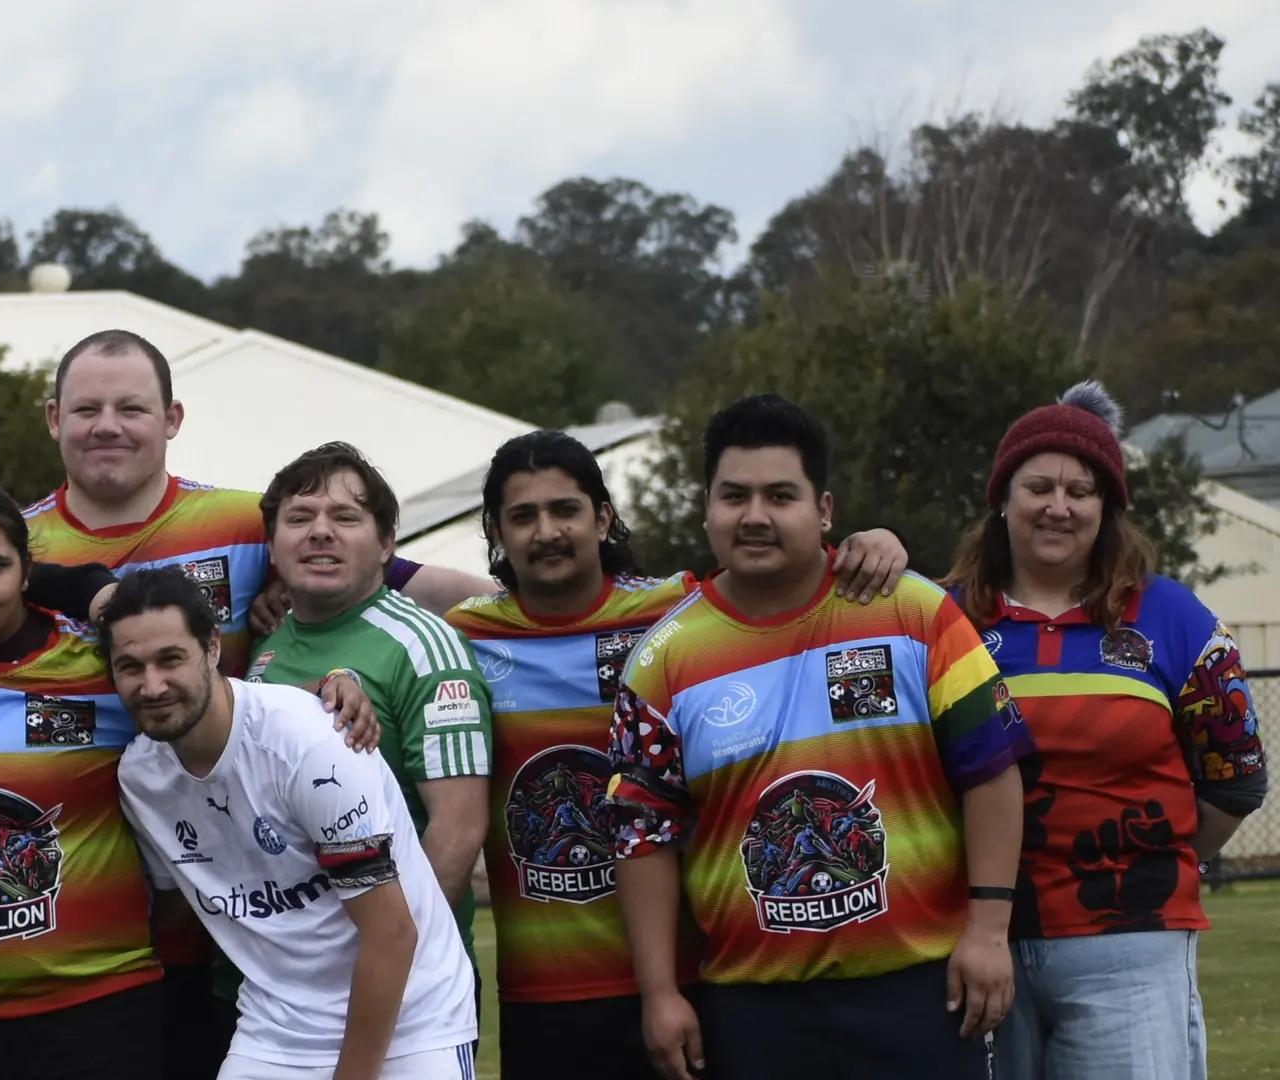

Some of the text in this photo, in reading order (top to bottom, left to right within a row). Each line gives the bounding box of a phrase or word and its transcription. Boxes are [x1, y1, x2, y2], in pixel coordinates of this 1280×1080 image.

[321, 794, 368, 841] brand
[527, 866, 616, 892] REBELLIO
[764, 884, 877, 922] REBELLION
